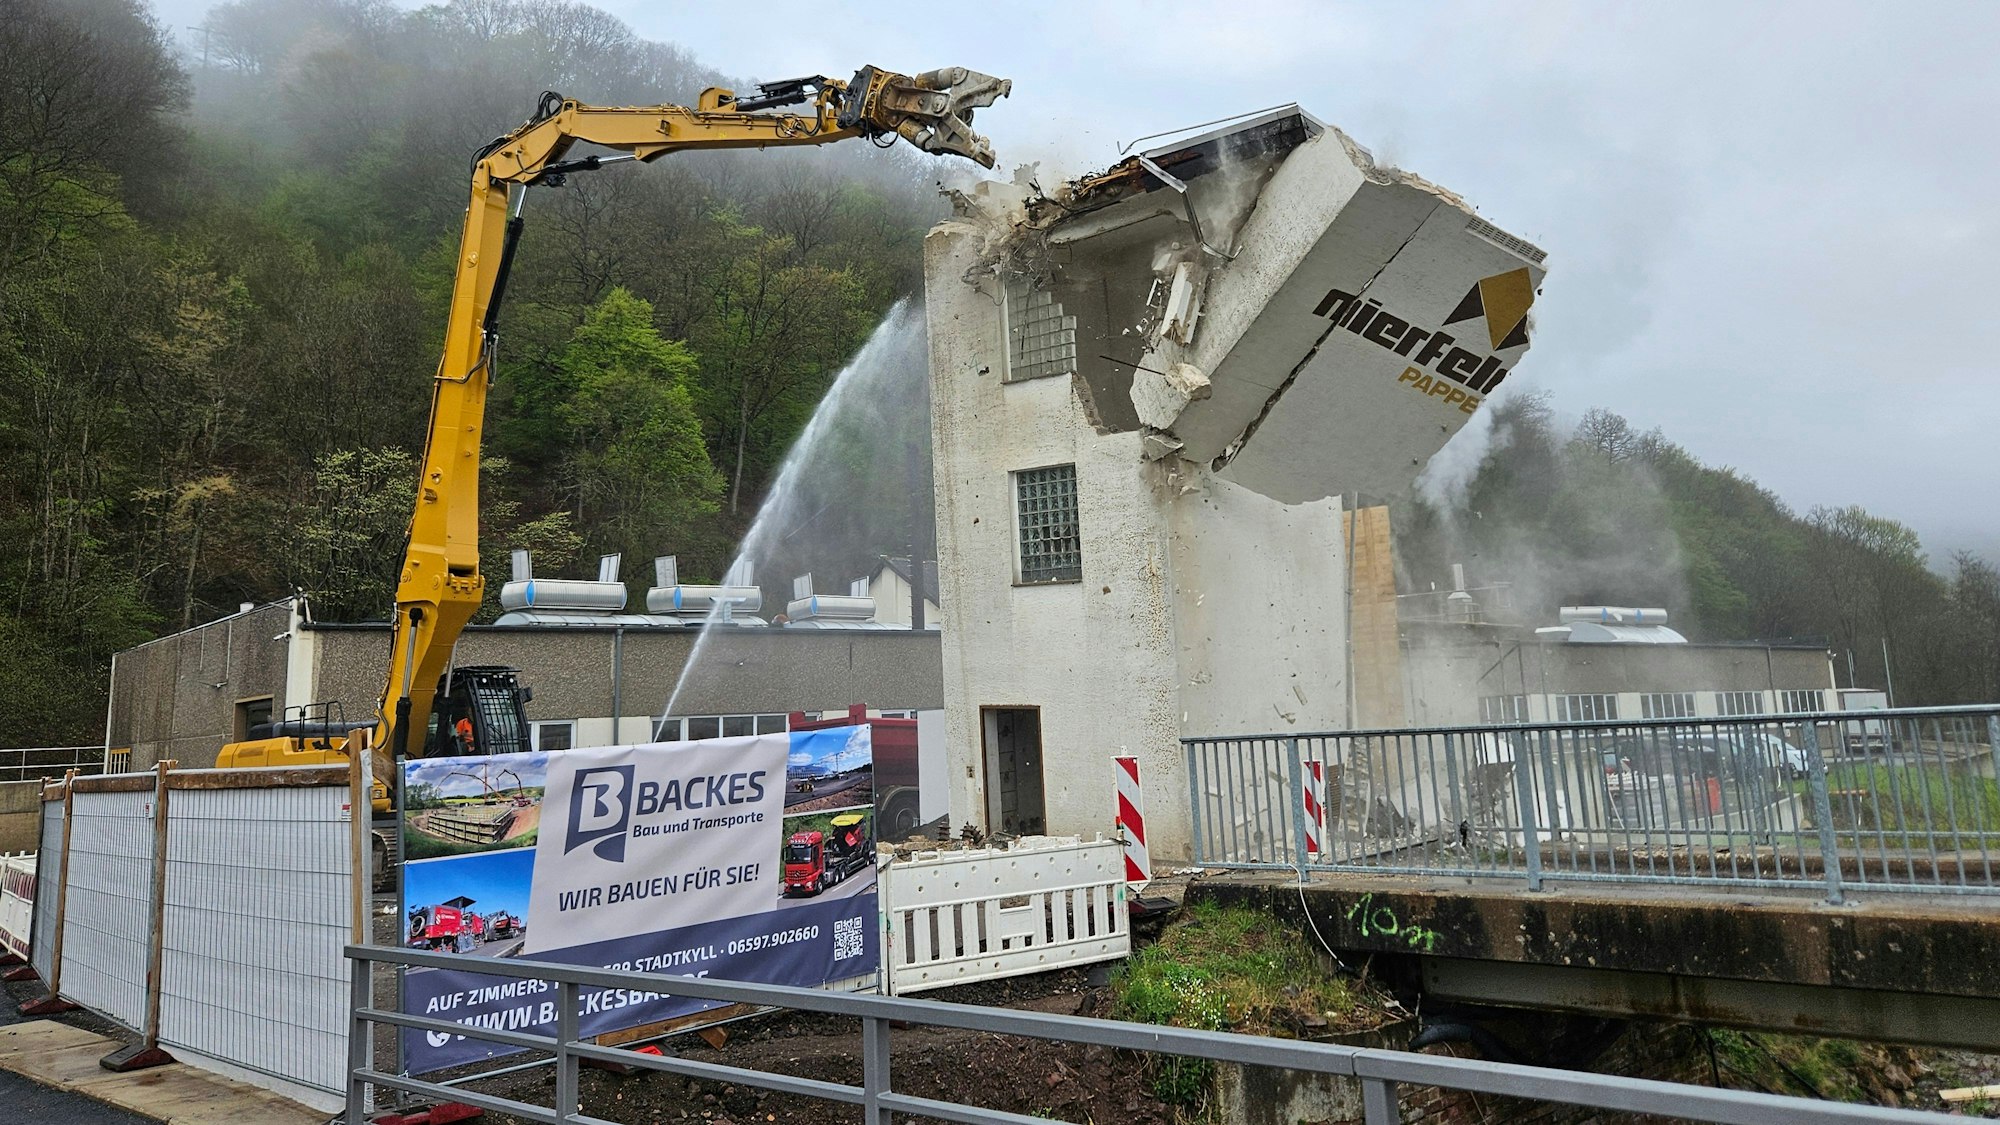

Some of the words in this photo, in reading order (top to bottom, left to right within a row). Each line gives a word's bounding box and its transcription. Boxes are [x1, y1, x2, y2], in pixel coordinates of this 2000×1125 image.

[1398, 366, 1482, 414] PAPPE
[636, 771, 766, 816] BACKES
[633, 825, 660, 838] Bau
[663, 819, 689, 834] und
[692, 812, 764, 831] Transporte
[559, 887, 602, 912] WIR
[607, 875, 678, 904] BAUEN
[683, 867, 721, 892] FÜR
[726, 863, 760, 886] SIE!
[426, 992, 464, 1014] AUF
[635, 945, 717, 973] STADTKYLL
[728, 925, 819, 956] 06597.902660
